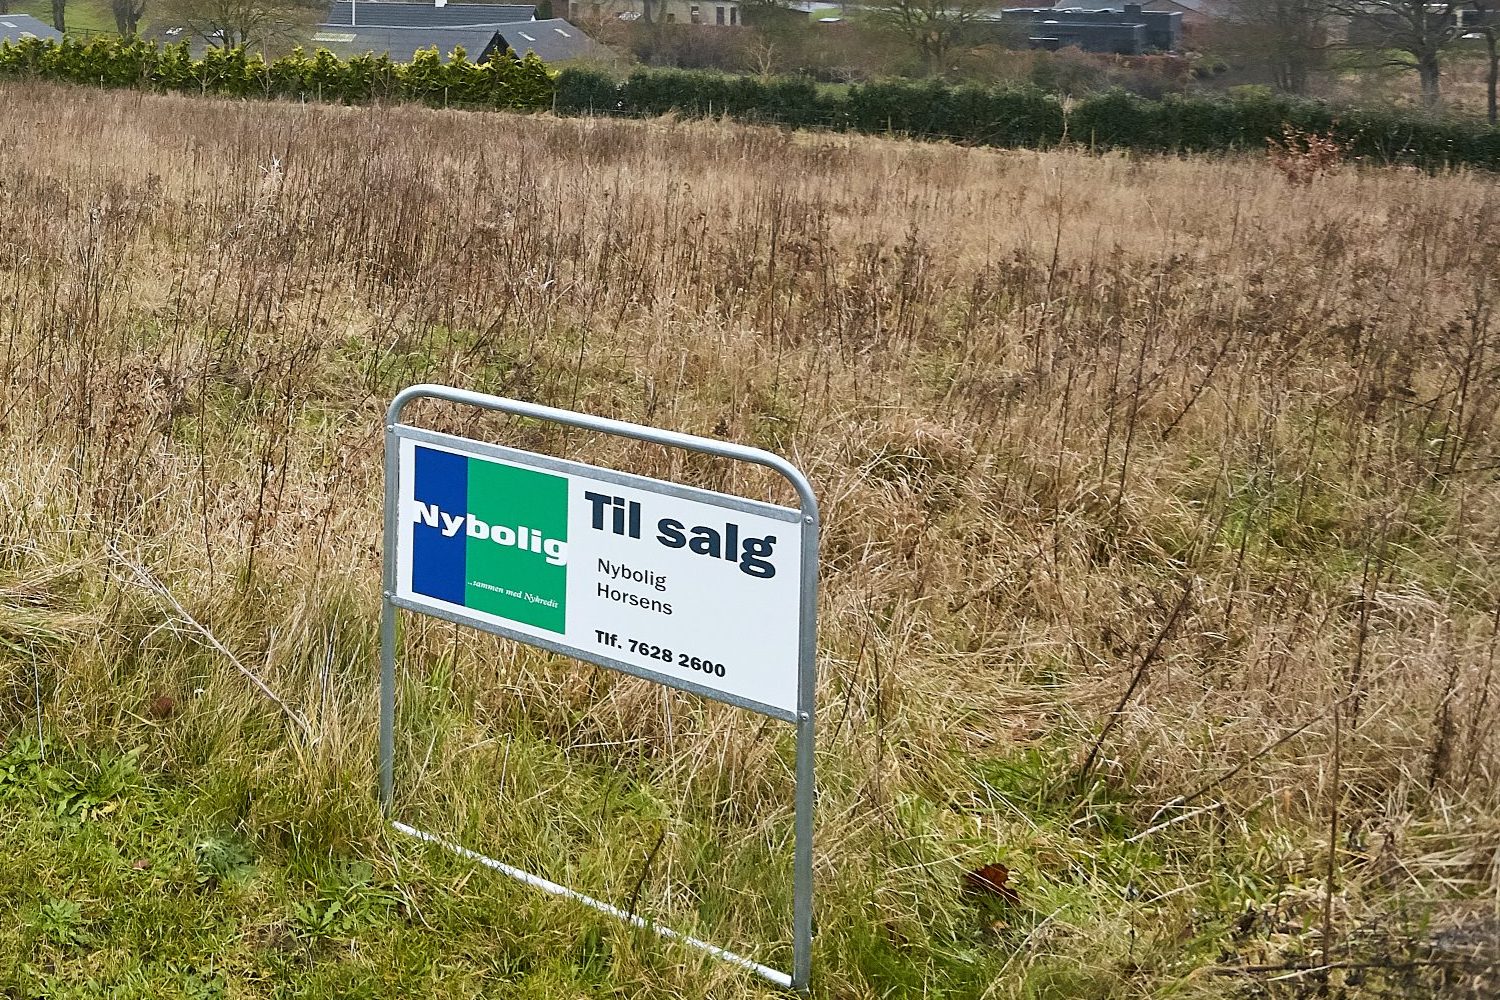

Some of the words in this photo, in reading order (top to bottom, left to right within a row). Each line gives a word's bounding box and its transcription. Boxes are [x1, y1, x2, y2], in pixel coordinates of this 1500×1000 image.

[414, 500, 567, 566] Nybolig
[585, 491, 641, 539] Til
[656, 518, 777, 579] salg
[598, 558, 667, 592] Nybolig
[505, 588, 523, 599] med
[523, 592, 558, 608] Nykredit
[597, 582, 673, 615] Horsens
[595, 629, 622, 649] Tlf.
[628, 638, 673, 663] 7628
[678, 653, 726, 678] 2600
